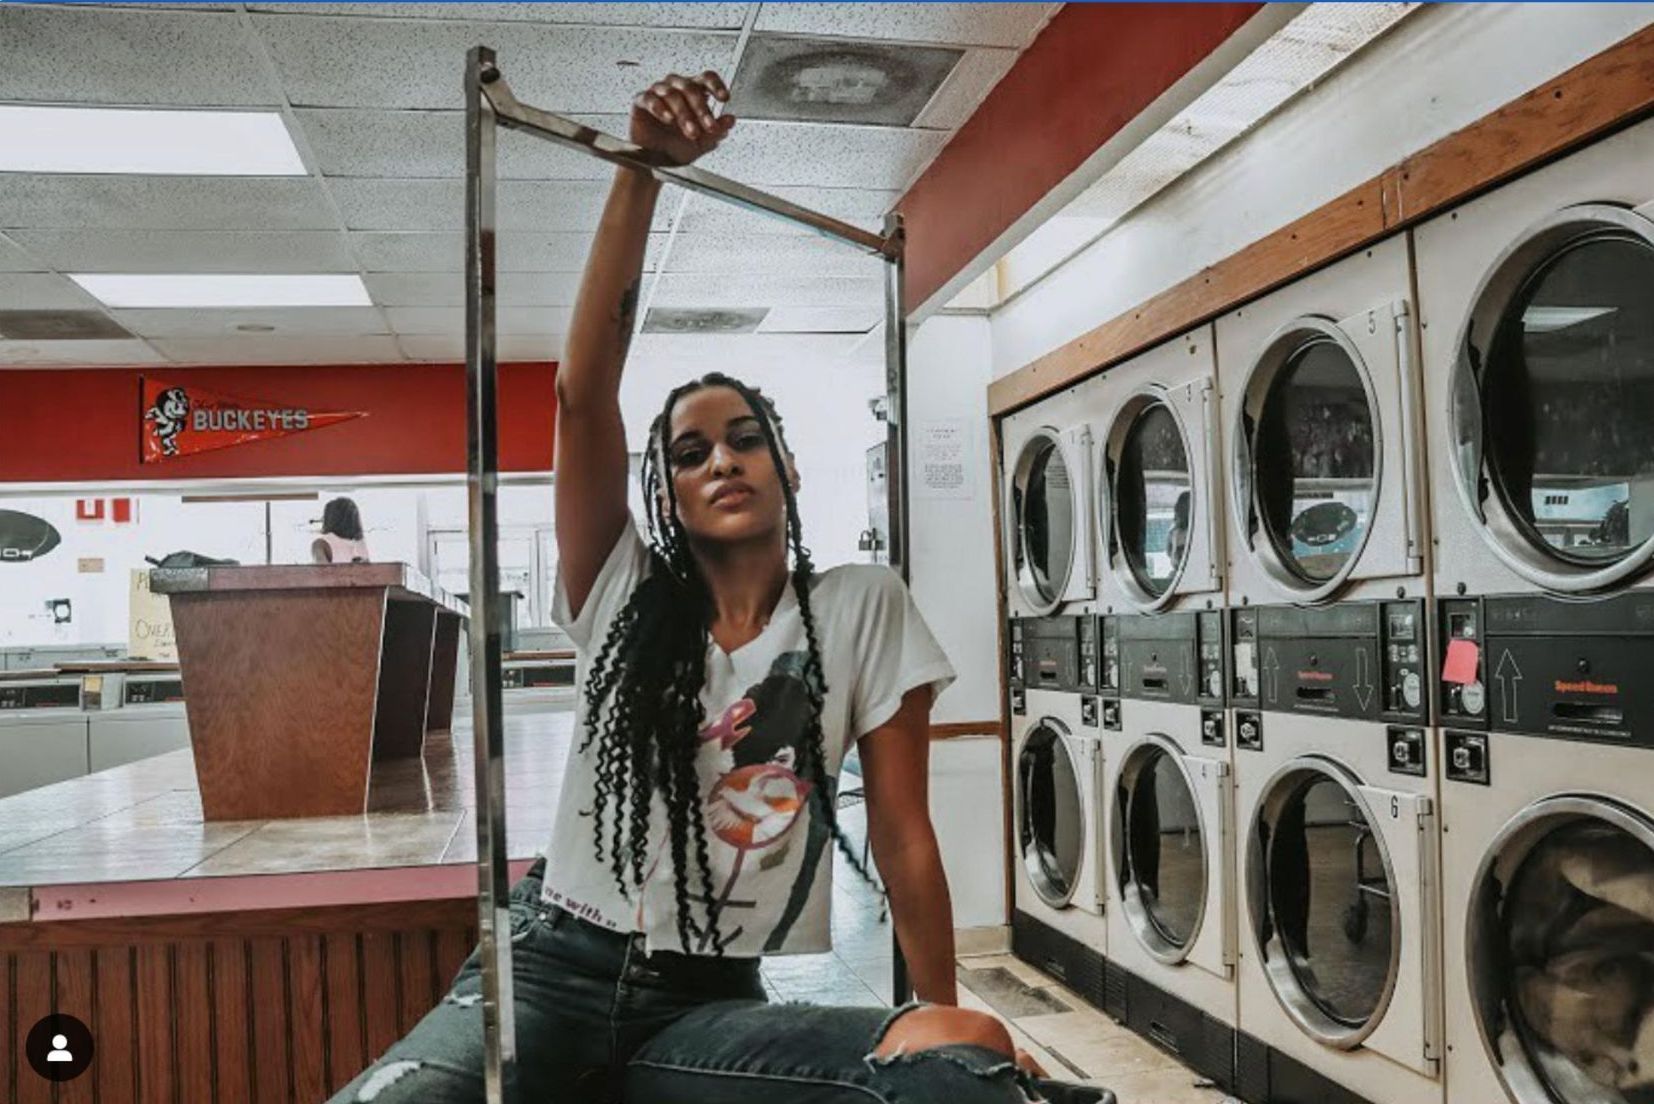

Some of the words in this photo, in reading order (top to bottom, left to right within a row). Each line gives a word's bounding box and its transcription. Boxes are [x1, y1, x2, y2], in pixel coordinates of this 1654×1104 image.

[193, 409, 309, 431] BUCKEYES
[1390, 794, 1399, 819] 6
[566, 898, 602, 922] with
